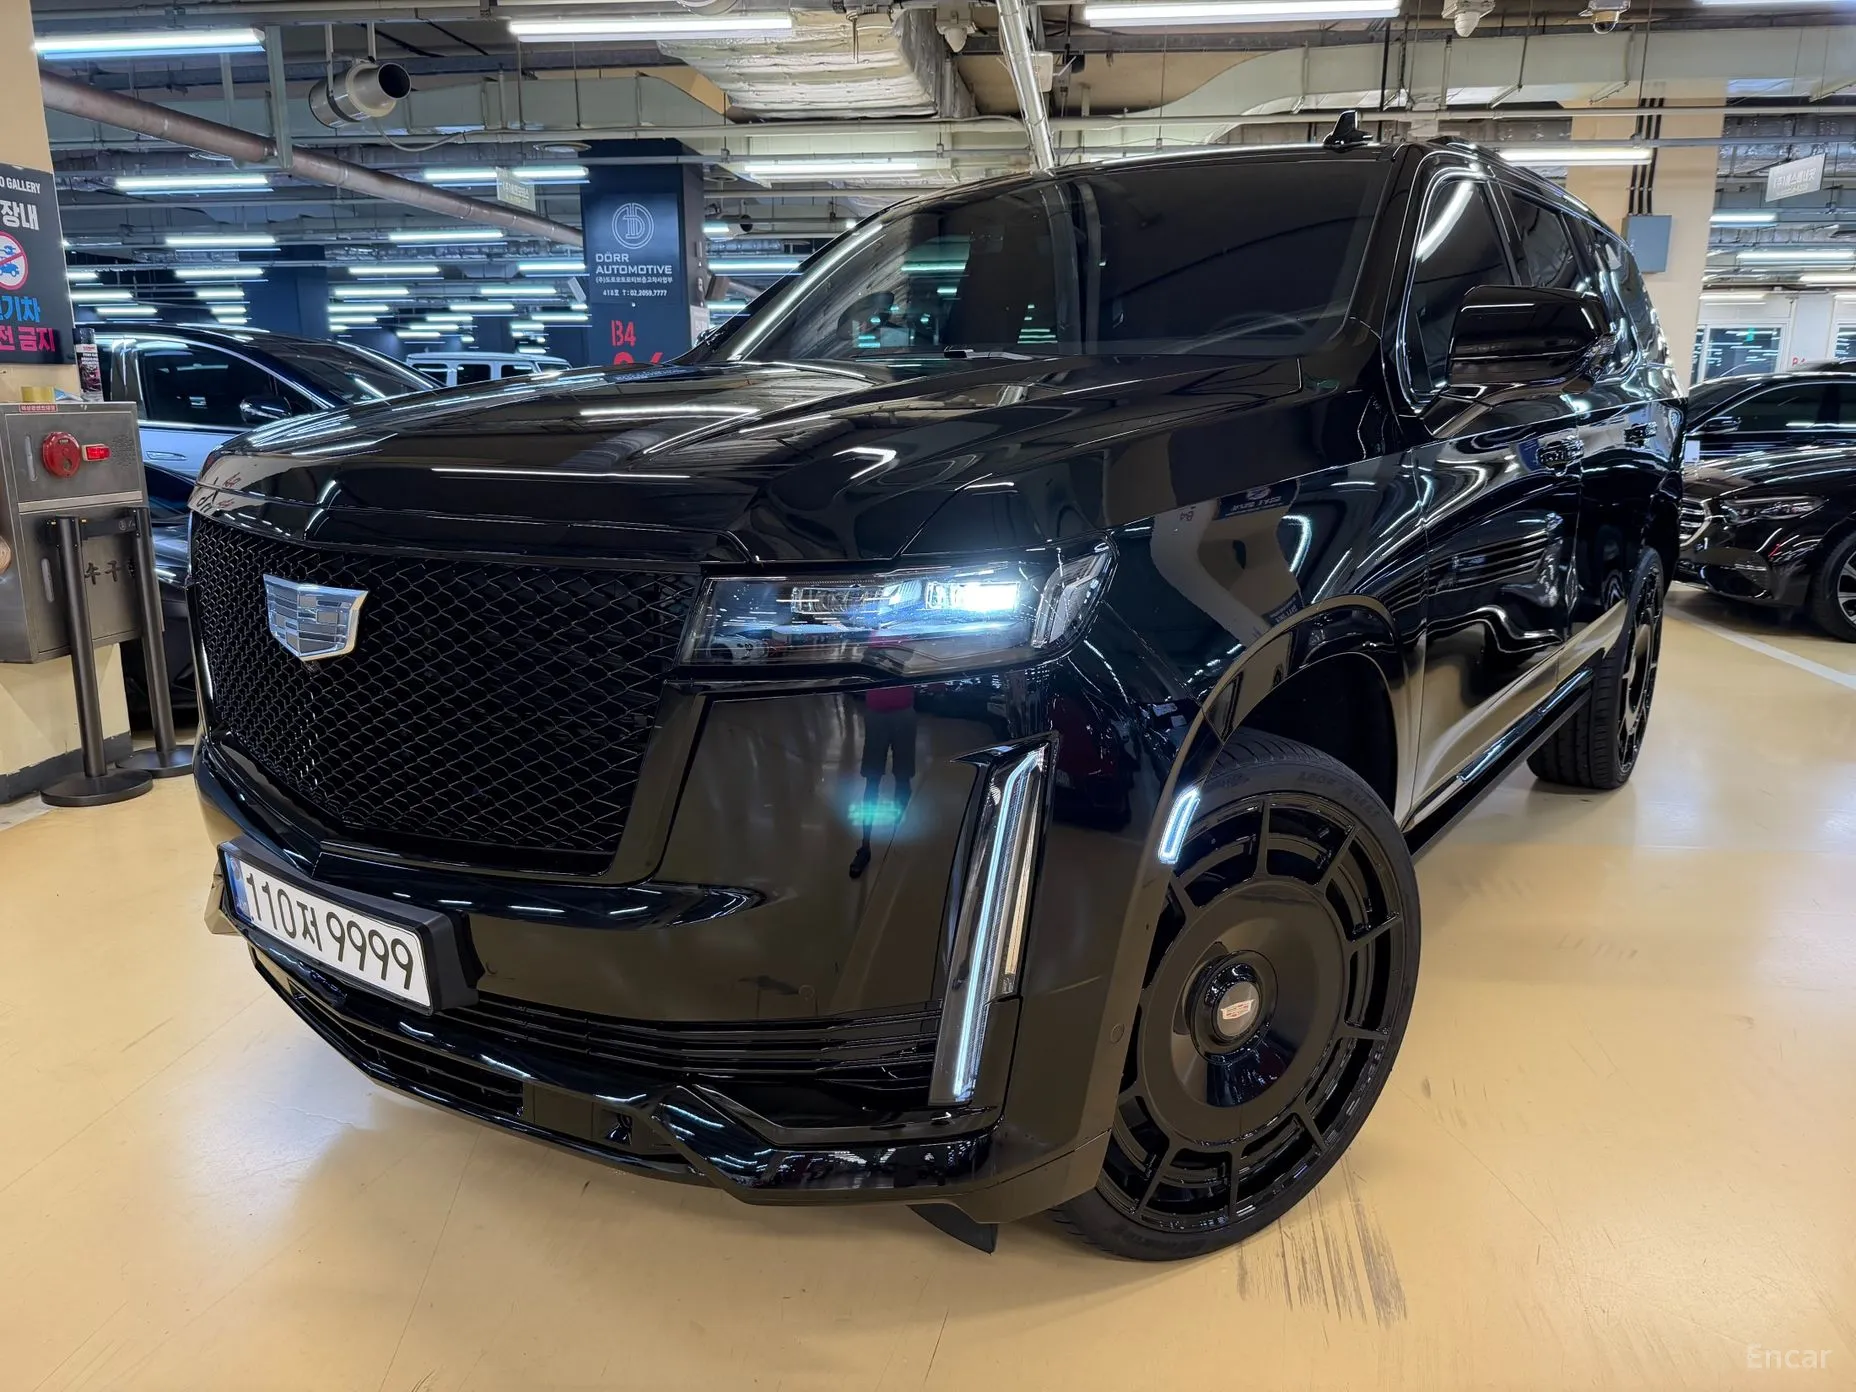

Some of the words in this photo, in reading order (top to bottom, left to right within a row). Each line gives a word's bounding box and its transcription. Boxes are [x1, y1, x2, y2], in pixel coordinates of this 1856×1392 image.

[6, 177, 41, 194] GALLERY
[0, 199, 40, 231] 장내
[595, 251, 629, 263] DÖRR
[595, 265, 673, 274] AUTOMOTIVE
[0, 295, 41, 323] 기차
[18, 326, 56, 352] 금지
[611, 319, 637, 348] B4
